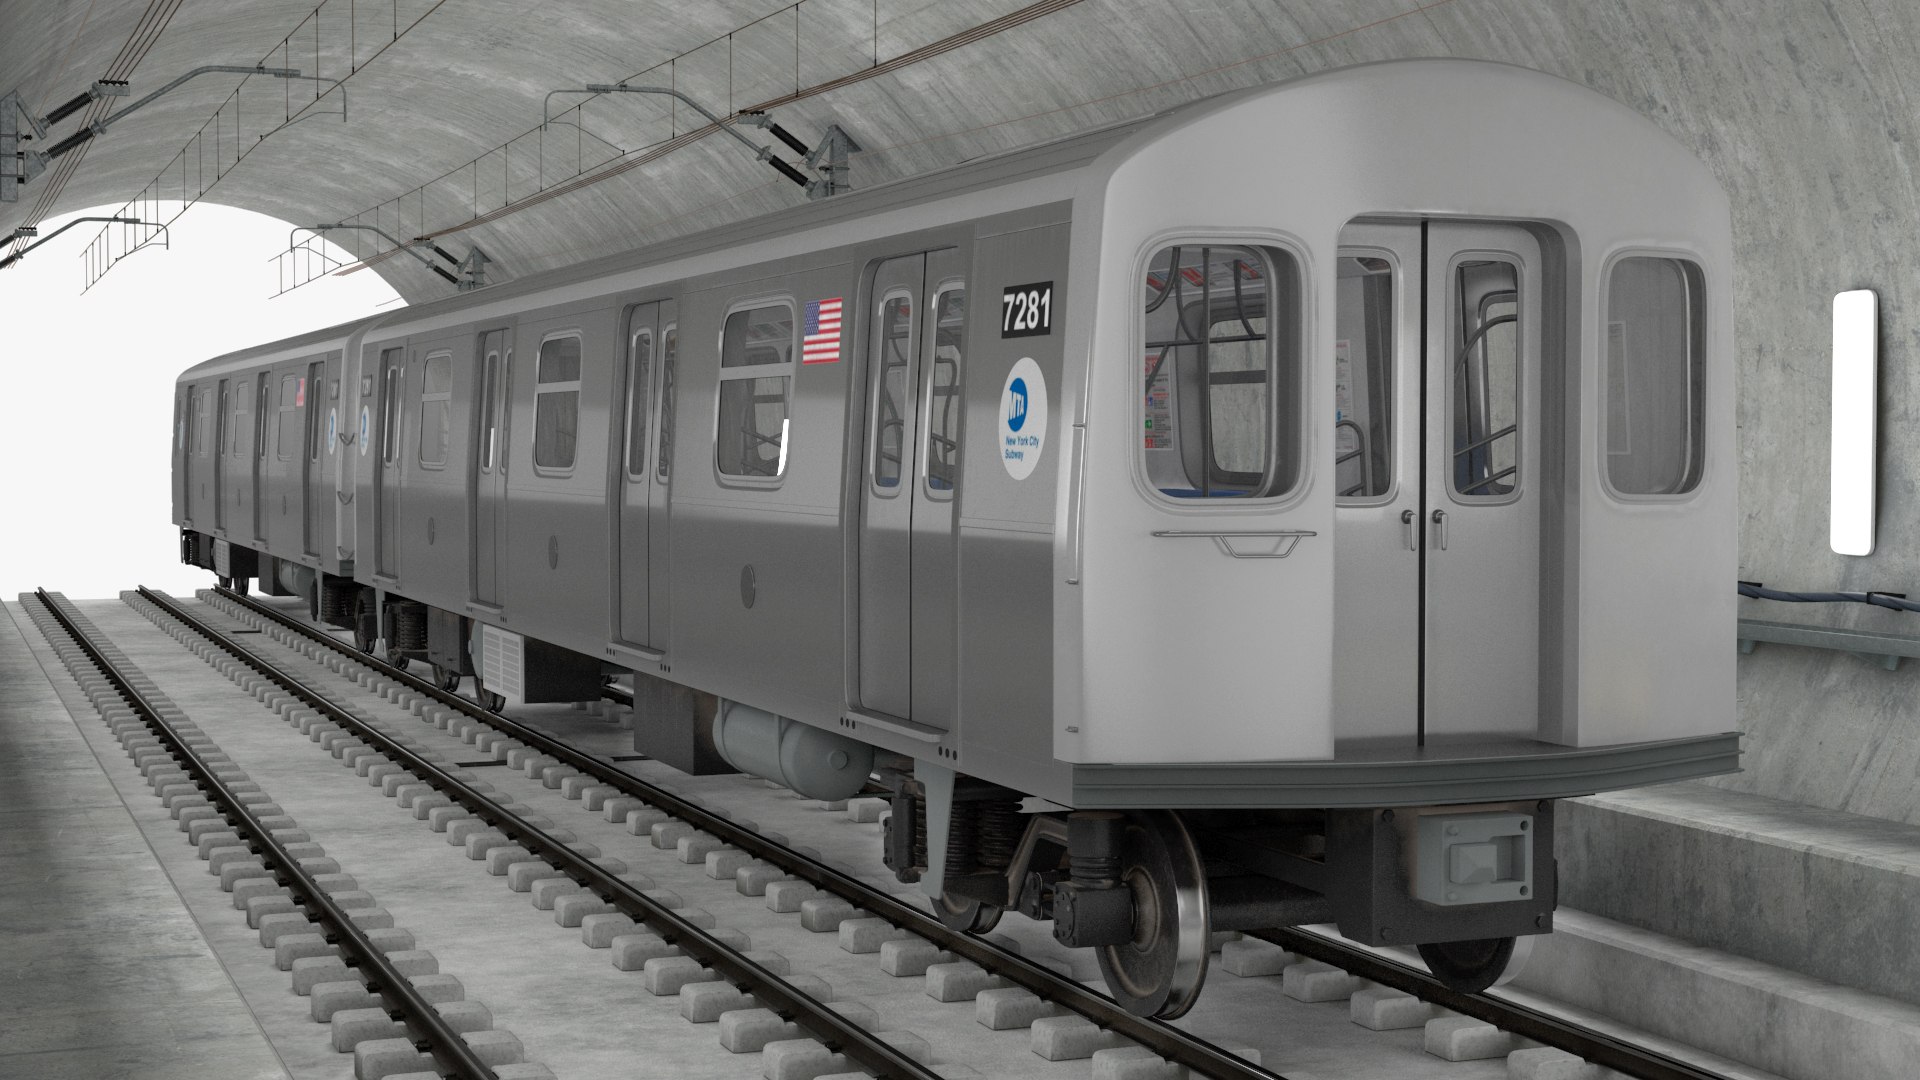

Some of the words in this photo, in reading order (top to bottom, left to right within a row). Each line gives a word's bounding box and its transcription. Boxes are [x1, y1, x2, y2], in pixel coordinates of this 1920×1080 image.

[1003, 287, 1050, 331] 7281
[1008, 390, 1025, 420] MTA
[1006, 436, 1016, 446] New
[1017, 435, 1028, 446] York
[1029, 435, 1040, 448] City
[1005, 448, 1024, 462] Subway
